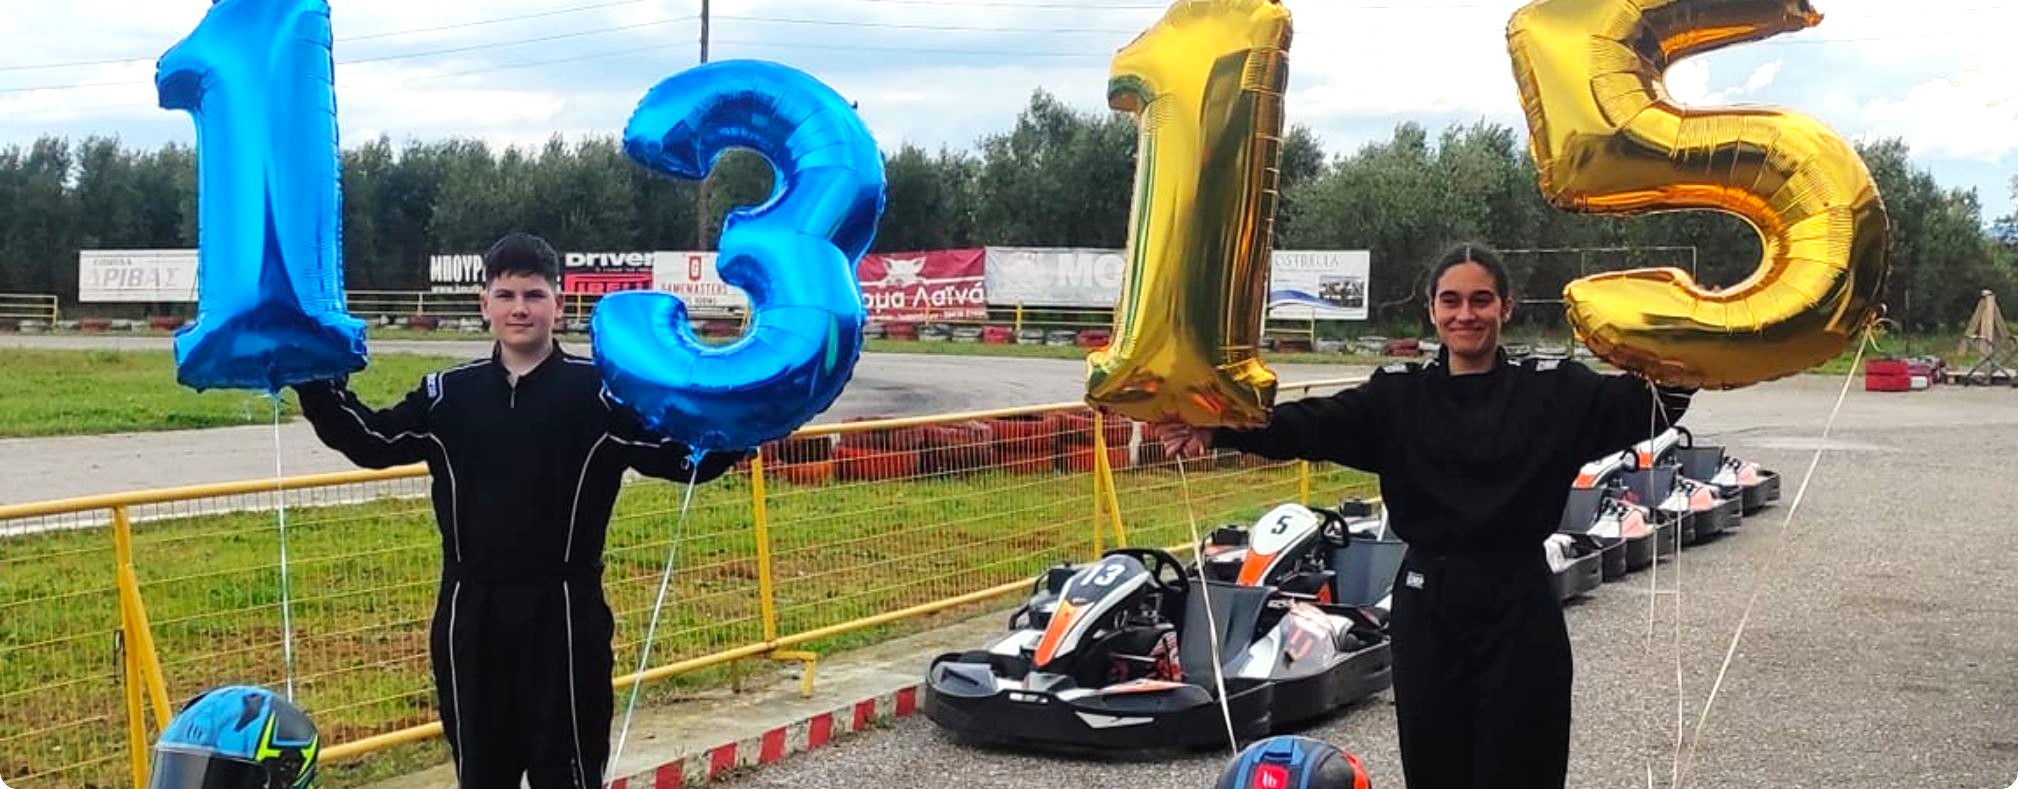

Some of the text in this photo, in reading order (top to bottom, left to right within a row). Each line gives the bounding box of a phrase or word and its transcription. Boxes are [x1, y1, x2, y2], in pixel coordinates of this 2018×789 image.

[156, 0, 887, 454] 1 3
[1085, 0, 1892, 428] 1 5
[1080, 563, 1125, 586] 13
[1271, 515, 1293, 535] 5
